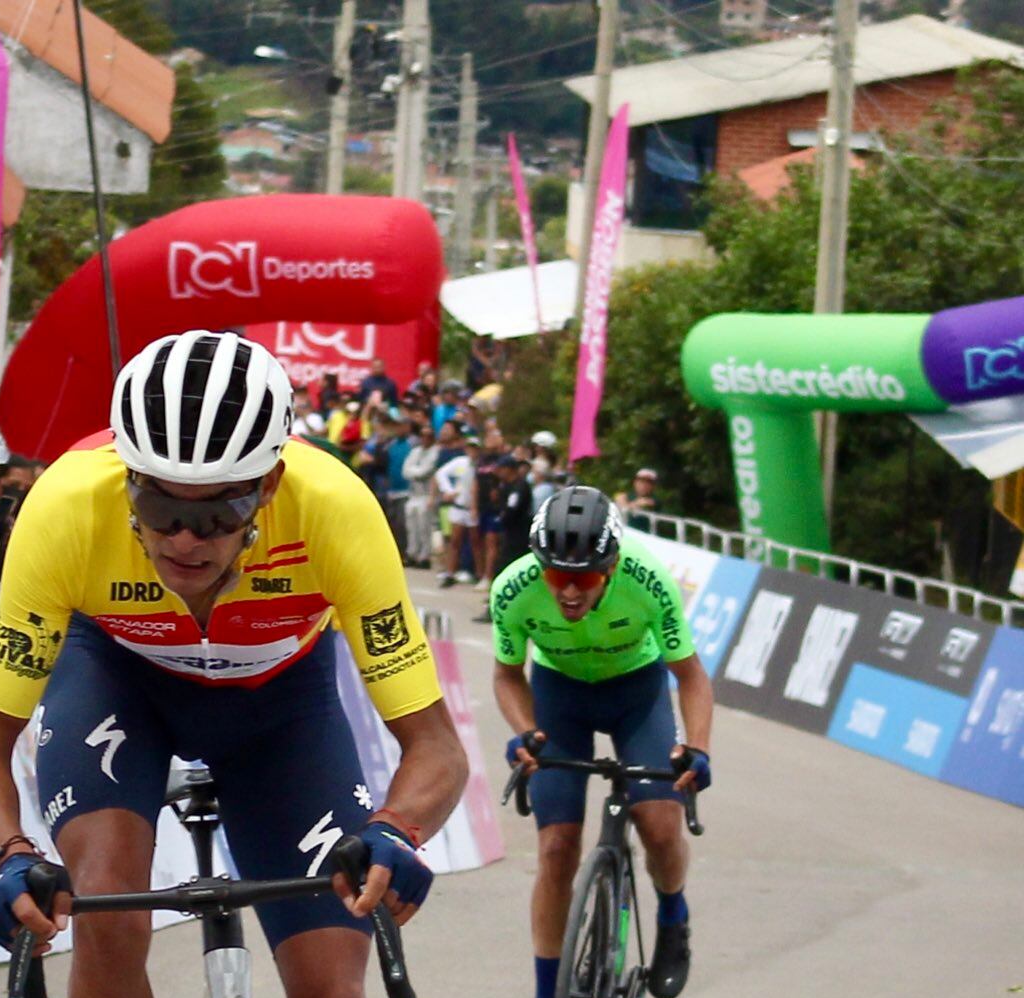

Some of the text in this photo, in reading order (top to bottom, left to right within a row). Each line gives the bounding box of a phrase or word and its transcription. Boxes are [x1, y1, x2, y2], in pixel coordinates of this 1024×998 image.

[263, 257, 375, 282] Deportes
[963, 333, 1024, 390] RC
[110, 582, 164, 602] IDRD
